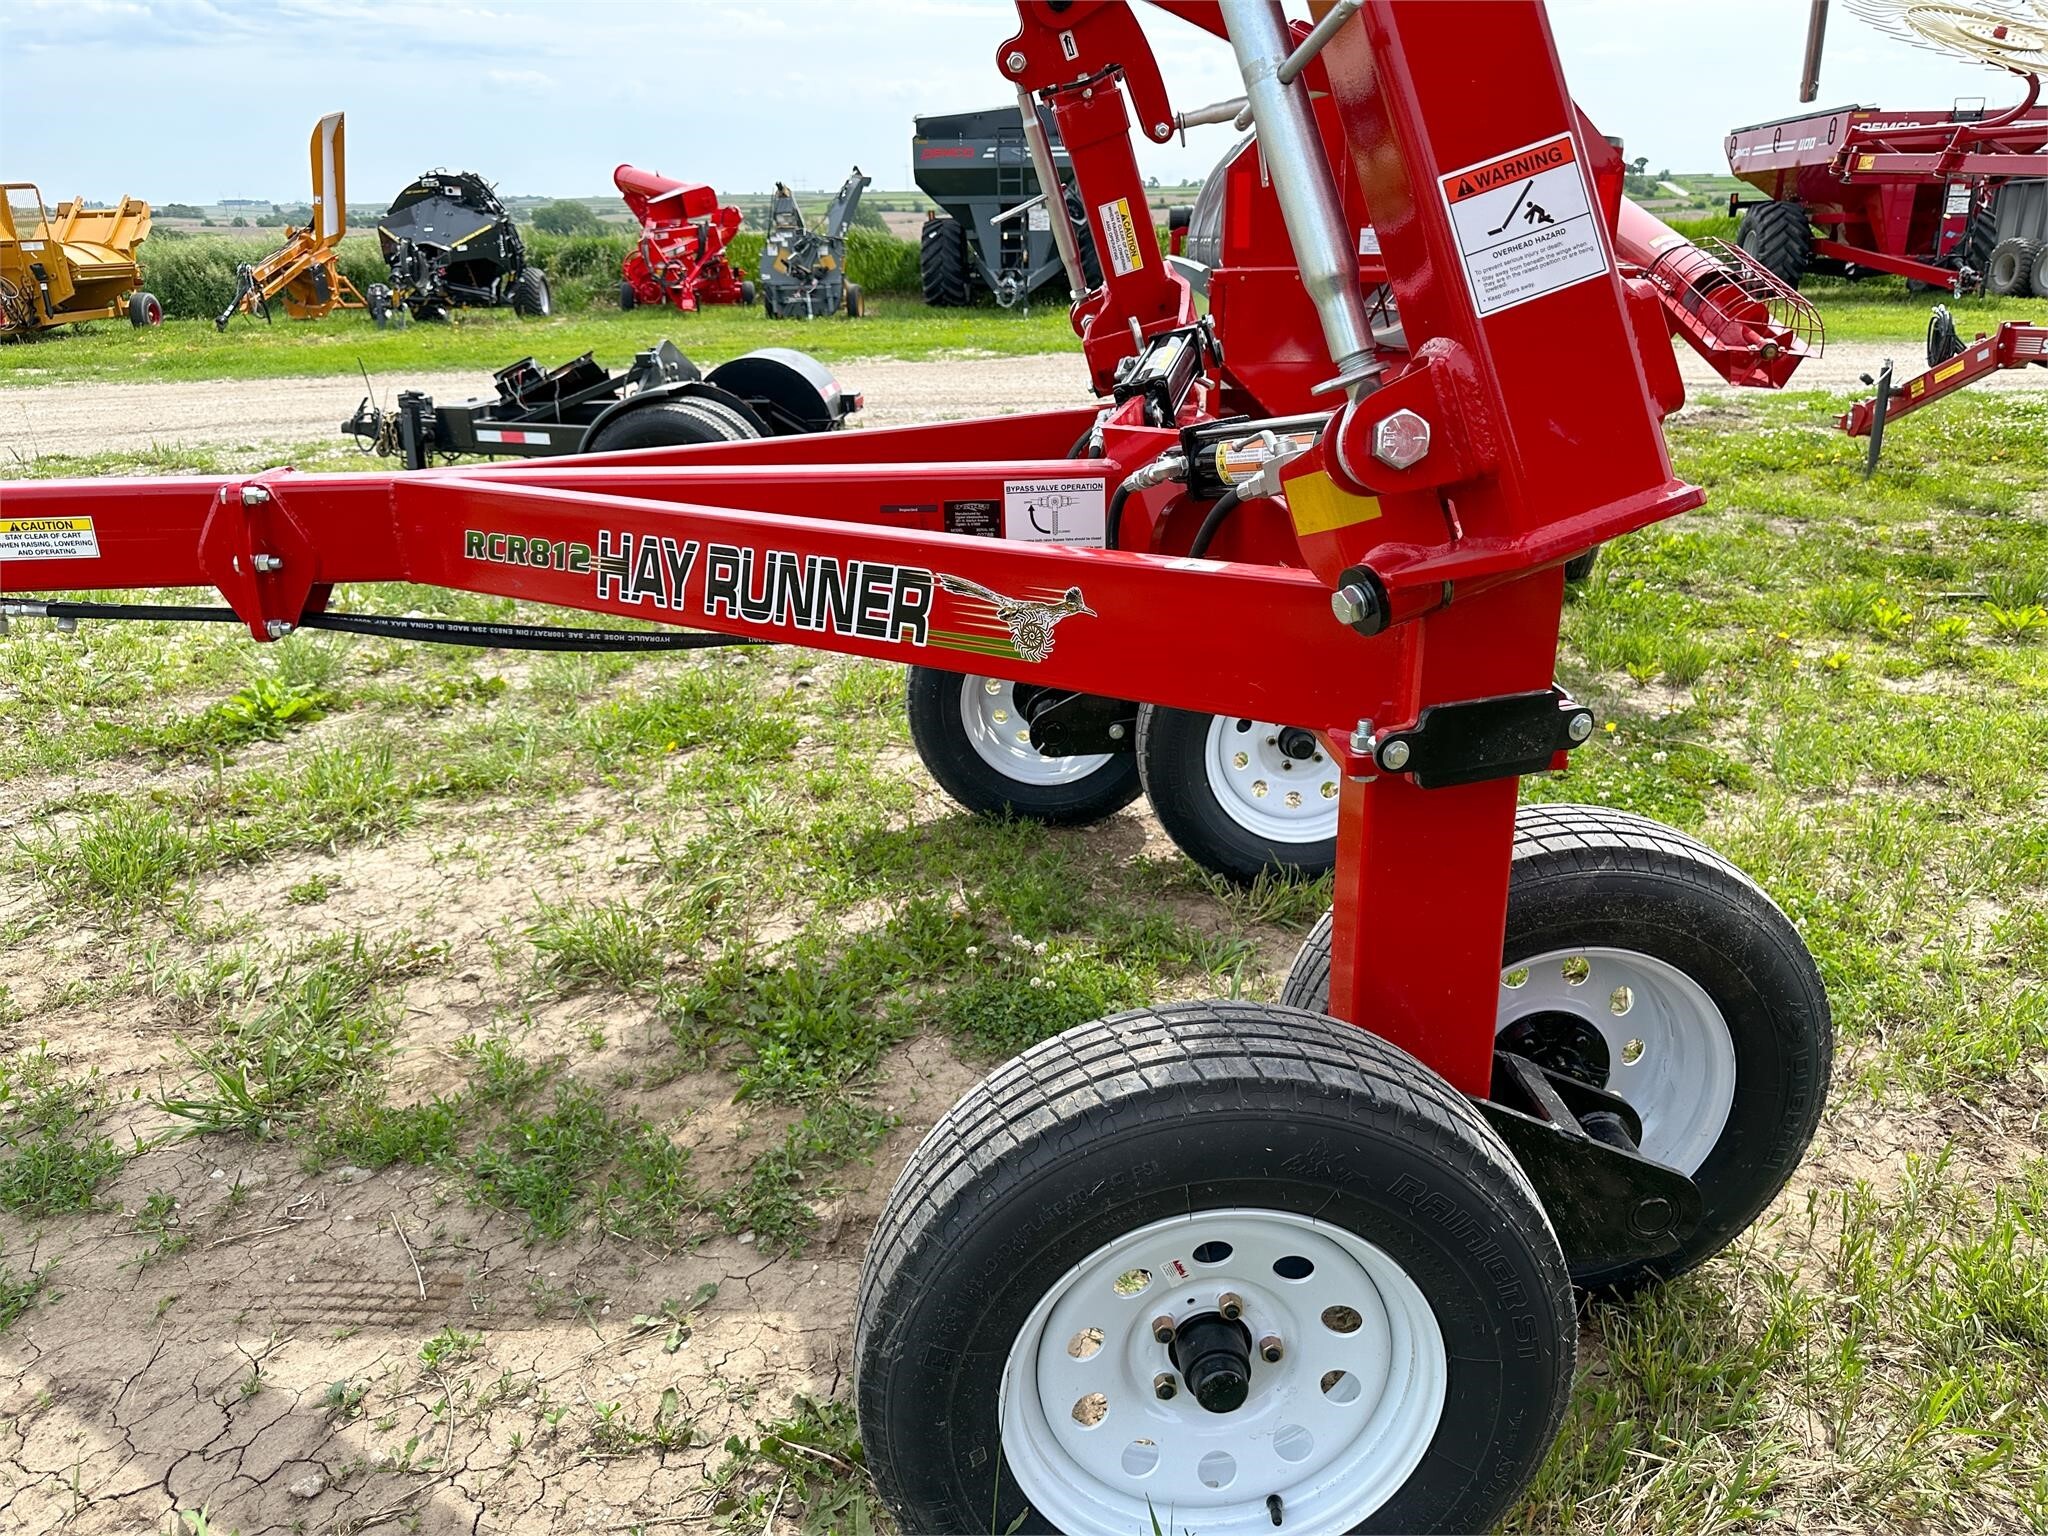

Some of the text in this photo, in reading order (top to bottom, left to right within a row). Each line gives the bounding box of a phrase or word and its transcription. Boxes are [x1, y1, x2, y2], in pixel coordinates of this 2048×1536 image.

[1473, 147, 1563, 189] WARNING
[1123, 221, 1138, 257] CAUTION
[1492, 228, 1567, 259] OVERHEAD HAZARD
[1481, 241, 1587, 283] Stay away from beneath the wings when
[1482, 262, 1503, 274] prevent
[1503, 255, 1524, 266] serious
[1523, 249, 1539, 259] injury
[1483, 279, 1495, 288] they
[1511, 270, 1521, 278] the
[1521, 264, 1539, 274] raised
[1538, 256, 1562, 270] position
[1578, 245, 1594, 256] being
[1487, 293, 1502, 302] Keep
[1502, 286, 1520, 297] others
[1006, 485, 1034, 493] BYPASS
[21, 521, 74, 531] CAUTION
[464, 529, 592, 574] RCR812
[597, 530, 933, 648] HAY RUNNER
[448, 624, 470, 632] MADE
[534, 630, 565, 638] 100R2AT
[604, 633, 624, 641] HOSE
[628, 634, 670, 643] HYDRAULIC
[1386, 1173, 1528, 1310] RAINIER
[1511, 1314, 1542, 1363] ST
